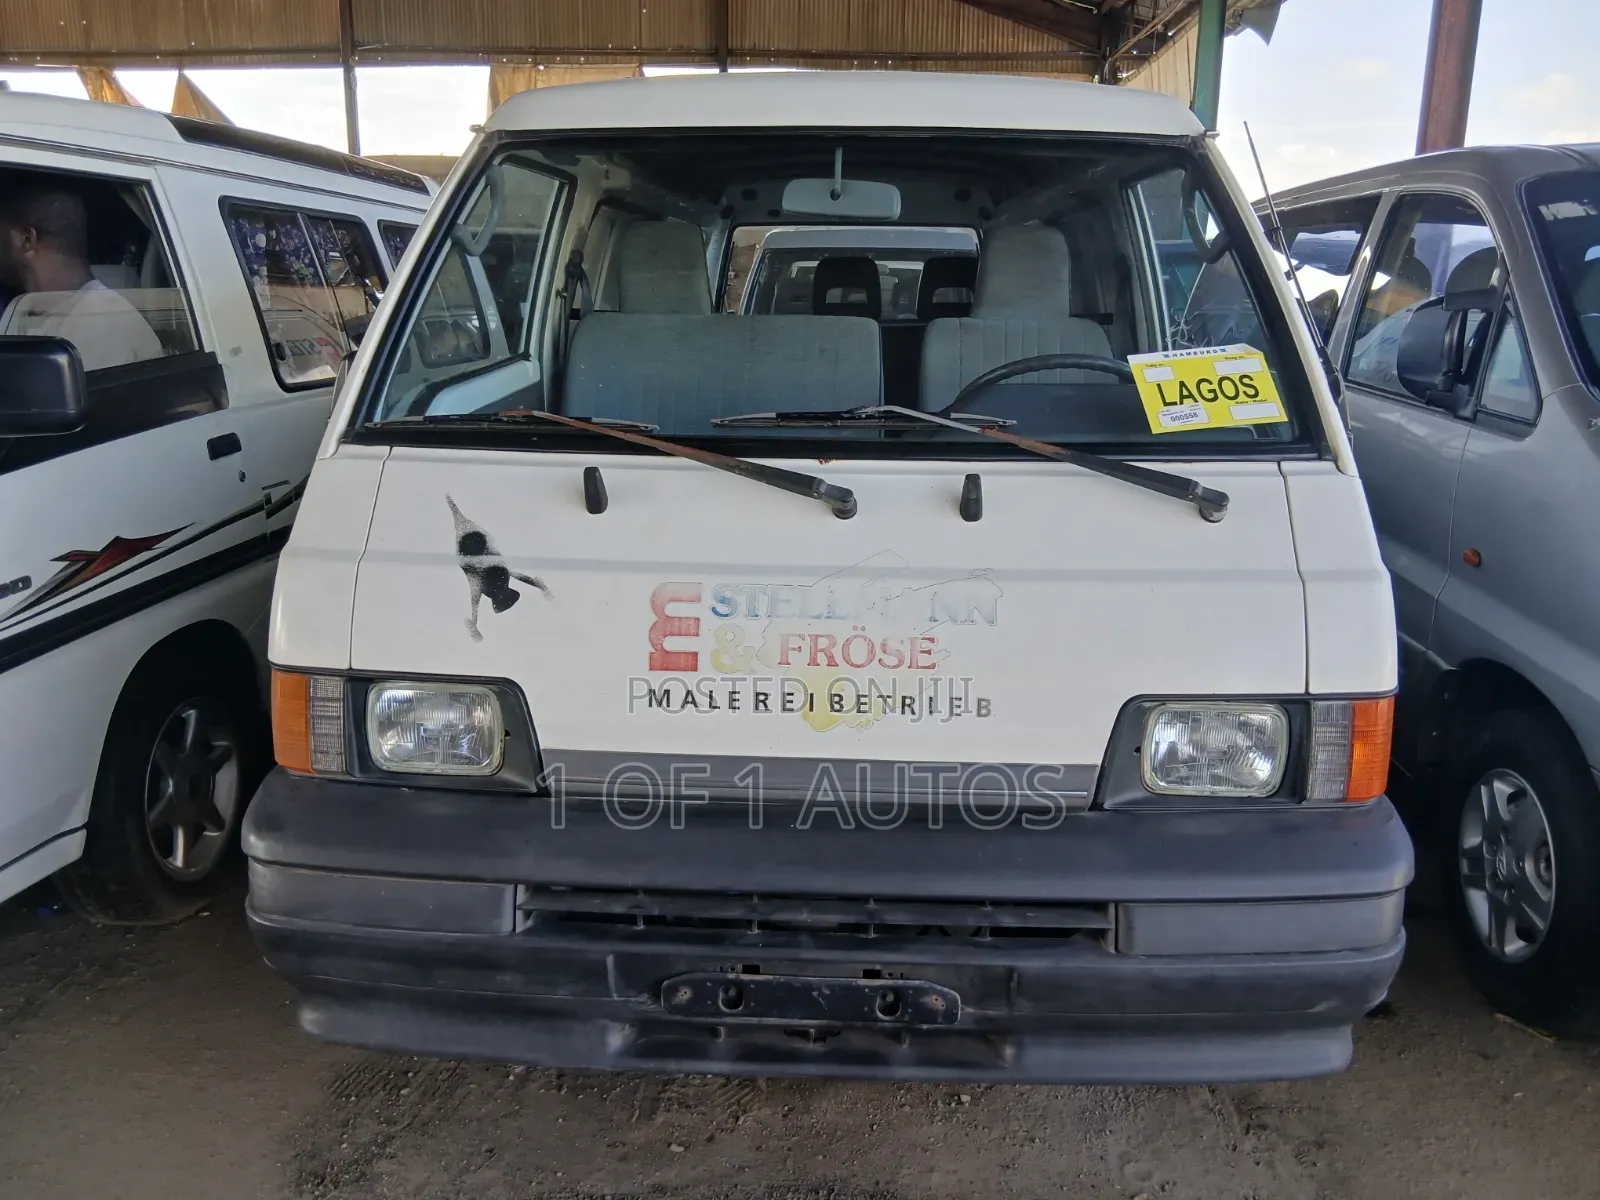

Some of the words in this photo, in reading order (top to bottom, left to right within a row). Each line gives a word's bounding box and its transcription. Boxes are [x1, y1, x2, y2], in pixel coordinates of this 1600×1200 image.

[1156, 374, 1260, 407] LAGOS
[709, 582, 998, 626] STELLNN
[777, 625, 938, 671] FRÖSE
